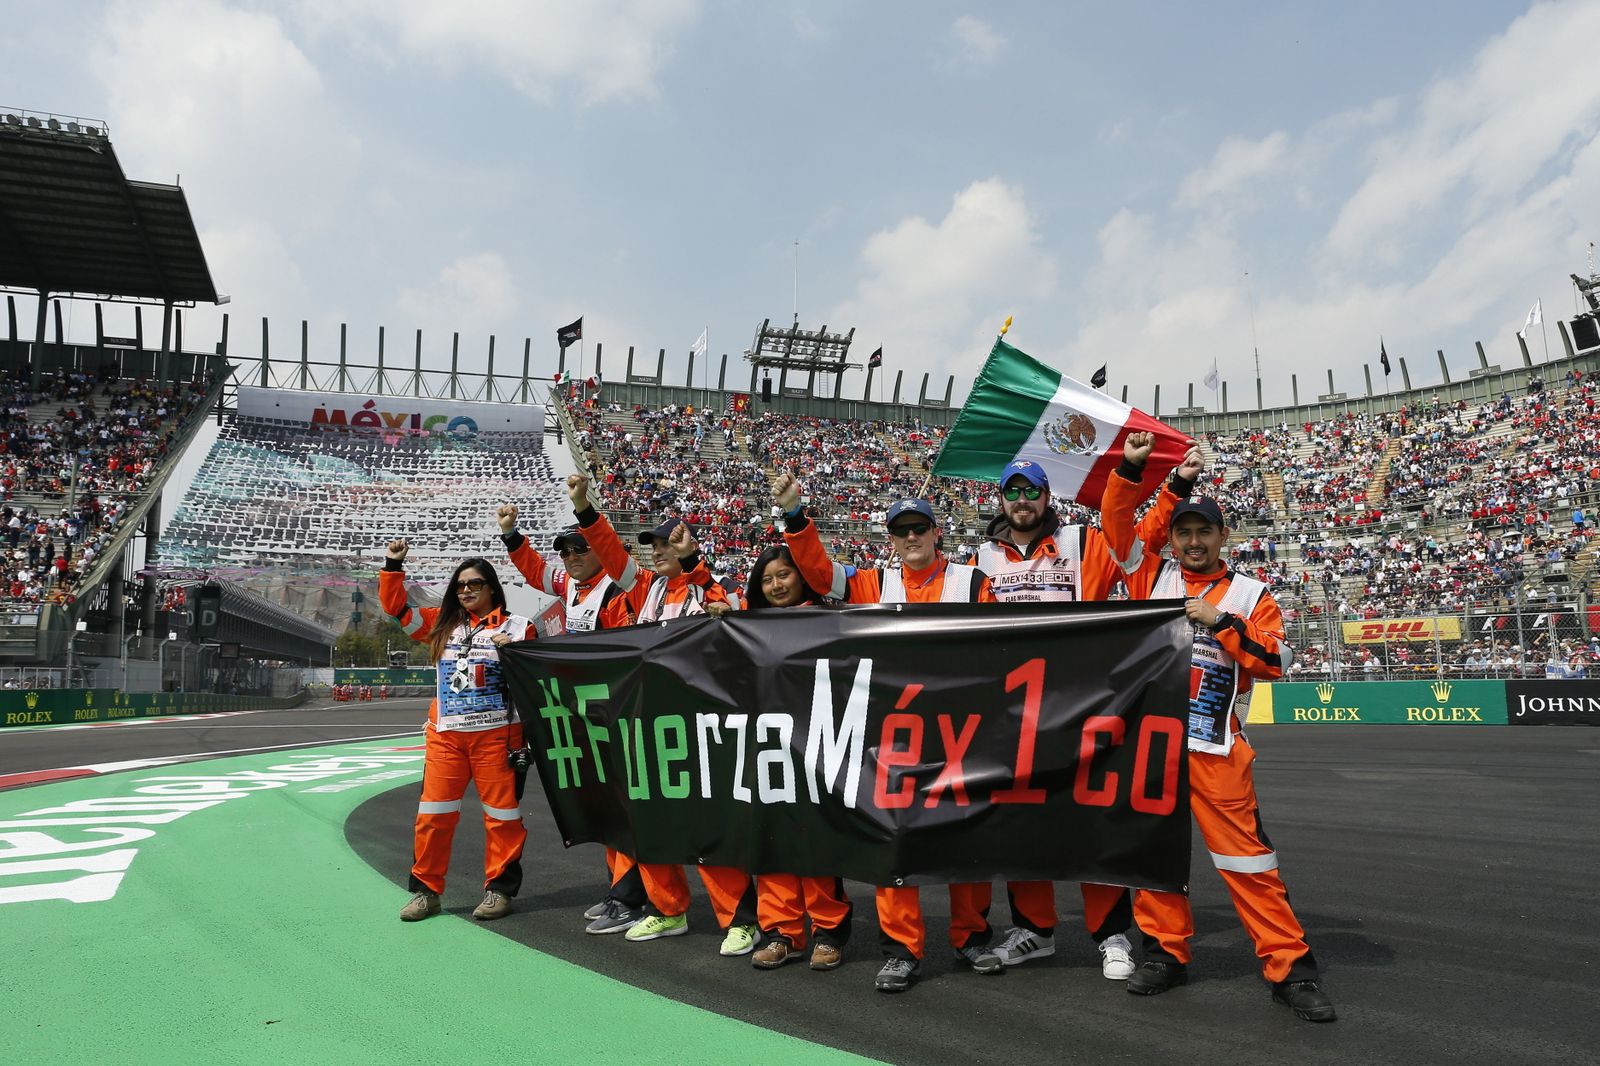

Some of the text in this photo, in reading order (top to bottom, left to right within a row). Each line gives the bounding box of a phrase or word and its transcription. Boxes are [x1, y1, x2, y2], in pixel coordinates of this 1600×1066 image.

[1360, 621, 1431, 640] DHL
[1516, 695, 1600, 717] JOHNN
[6, 711, 53, 724] ROLEX
[74, 708, 98, 720] ROLEX
[1293, 707, 1362, 721] ROLEX
[1406, 707, 1482, 721] ROLEX
[537, 657, 1186, 816] #FuerzaMéx1co
